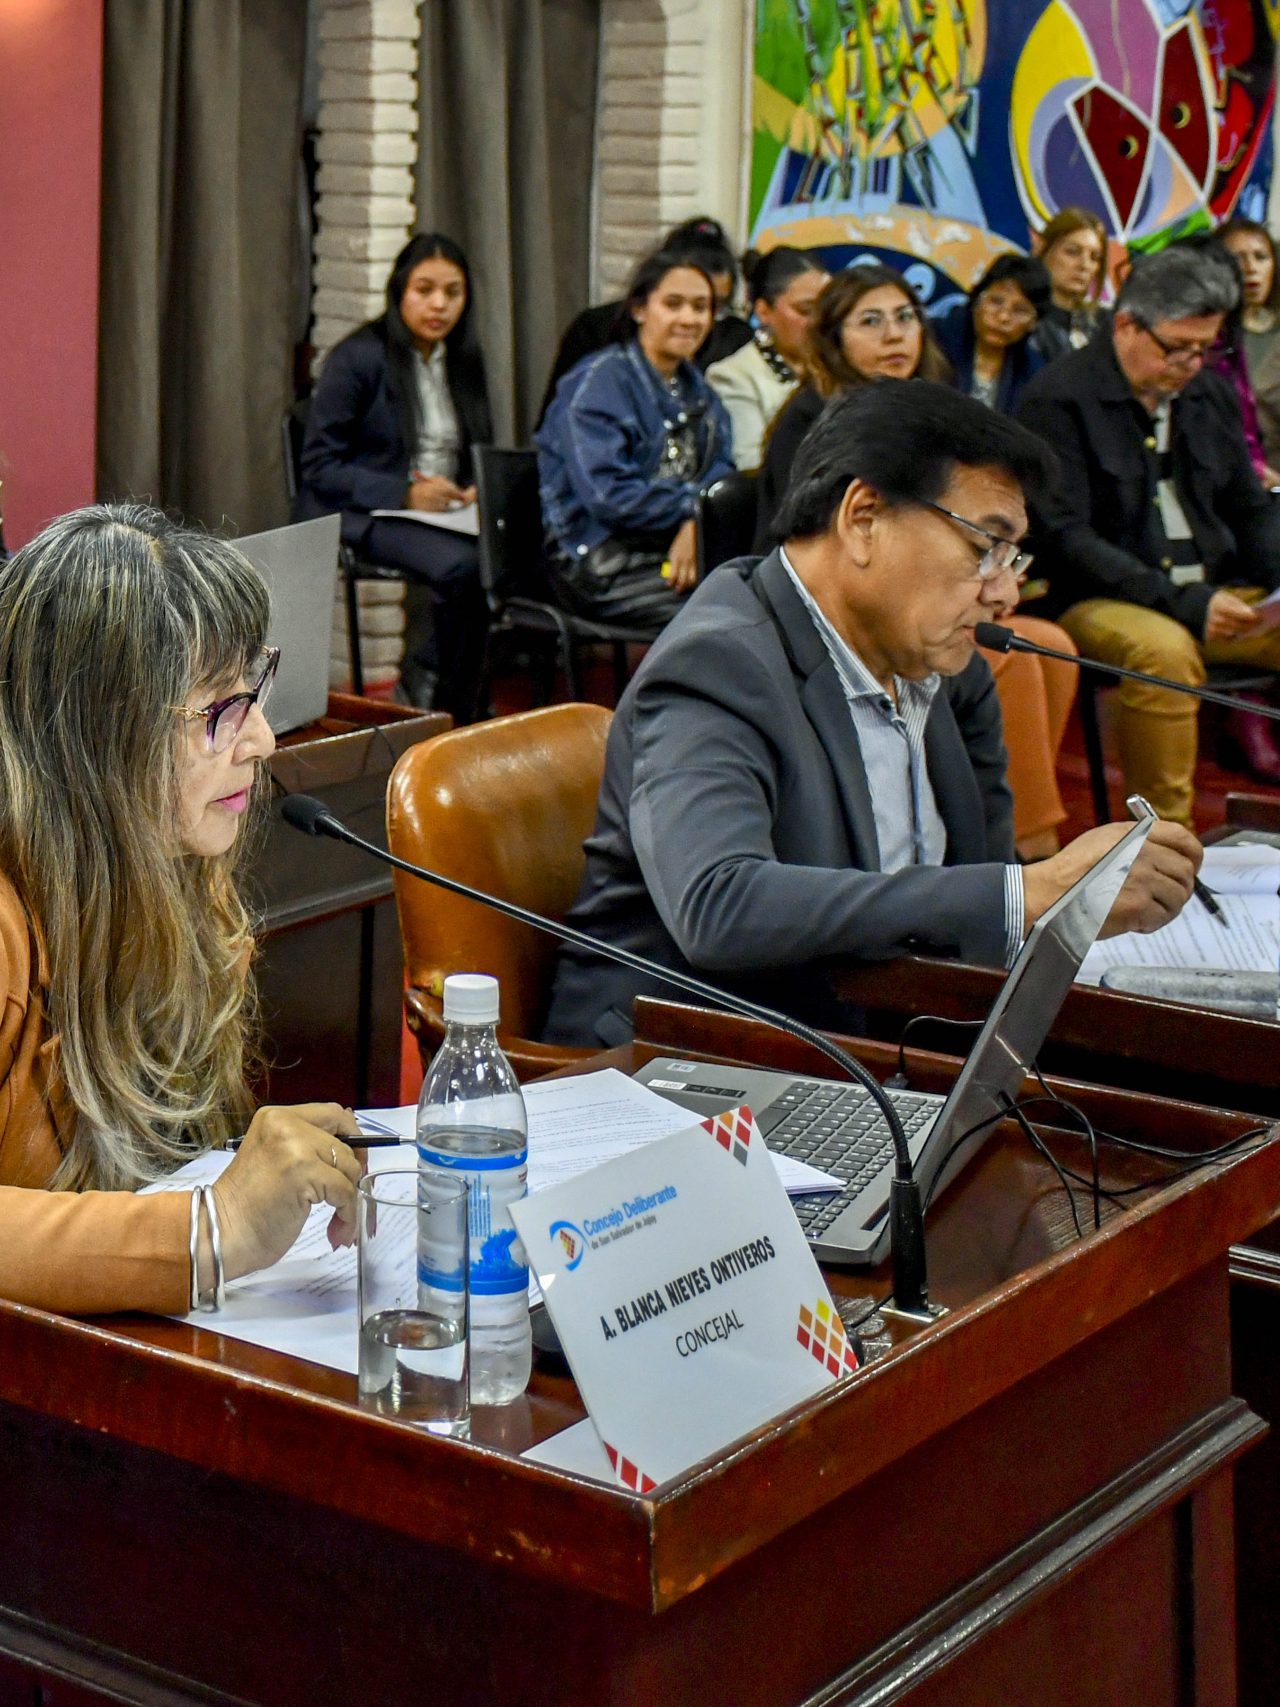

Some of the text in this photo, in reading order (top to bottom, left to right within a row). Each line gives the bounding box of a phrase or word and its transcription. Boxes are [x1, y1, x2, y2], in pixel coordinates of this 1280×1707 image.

[583, 1185, 678, 1237] Concejo Deliberante
[600, 1235, 776, 1341] A. BLANCA NIEVES ONTIVEROS
[675, 1309, 744, 1358] CONCEJAL
